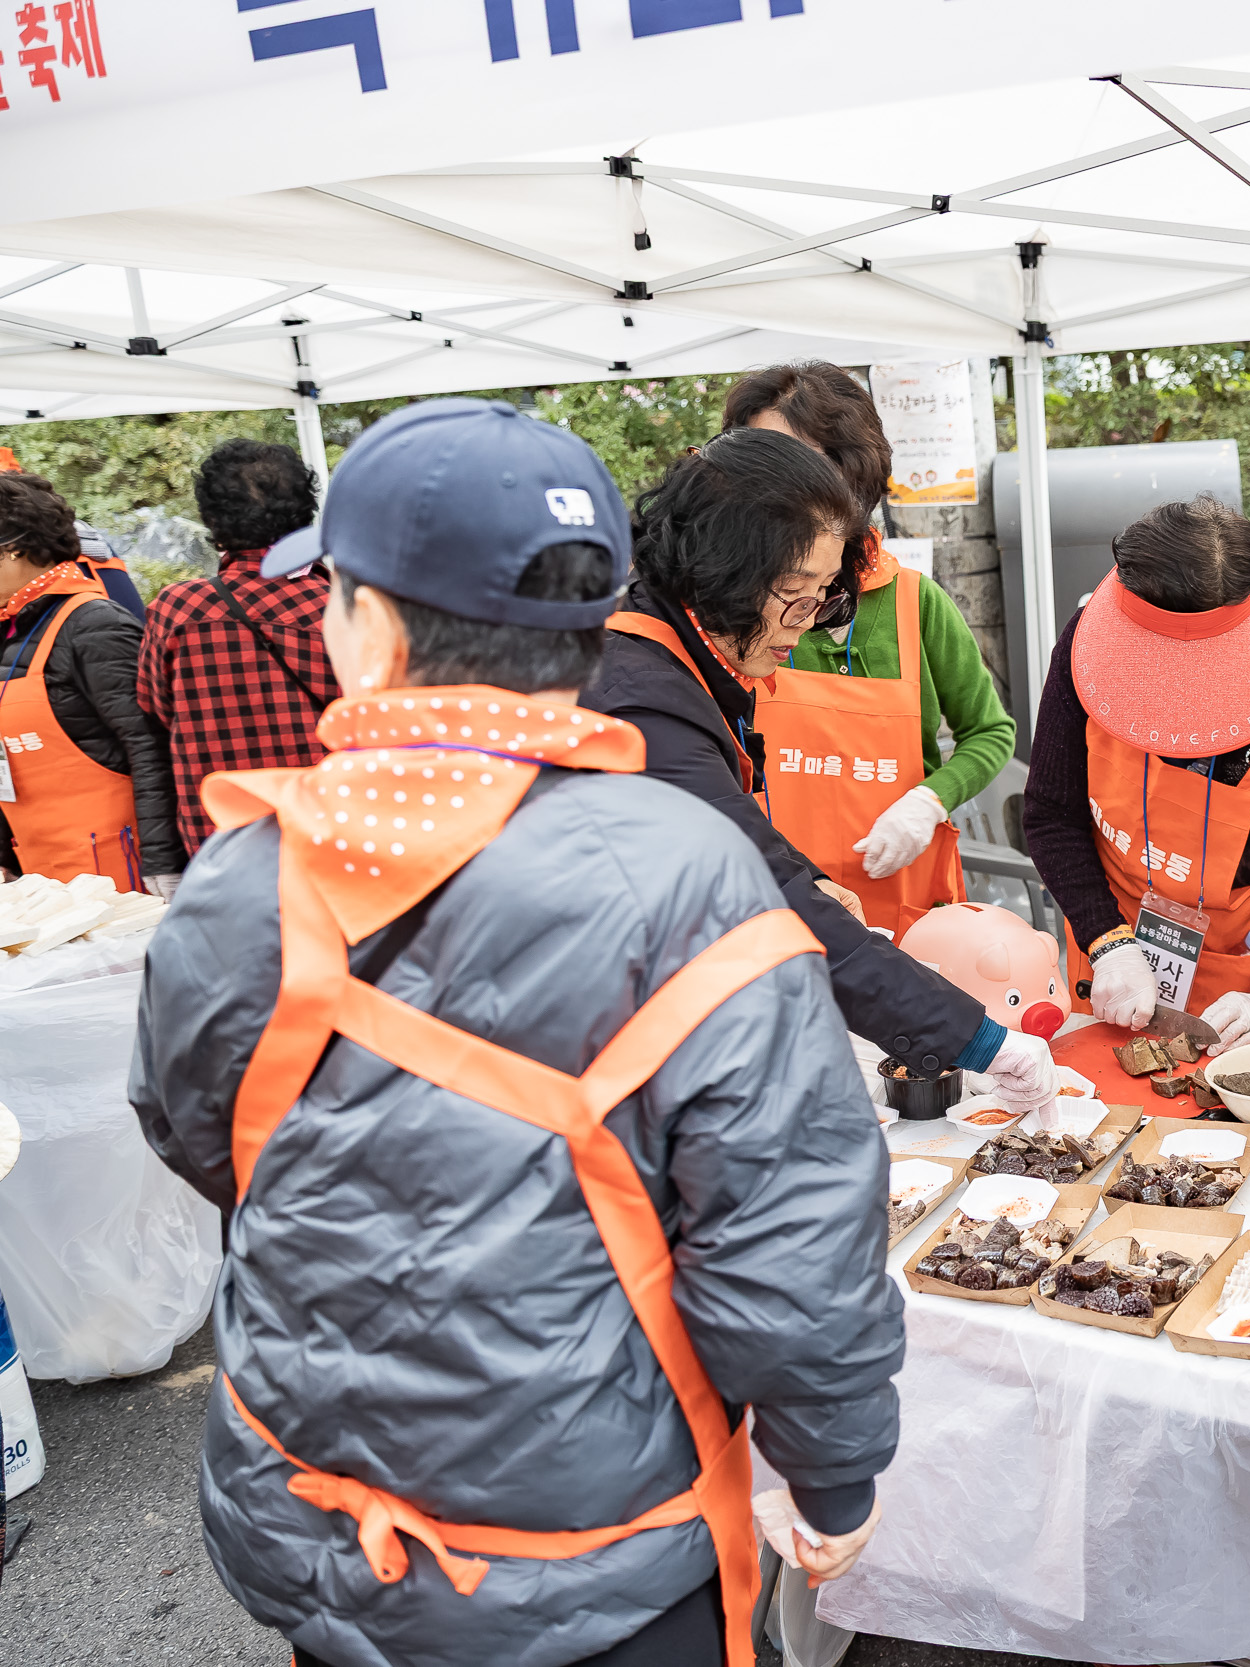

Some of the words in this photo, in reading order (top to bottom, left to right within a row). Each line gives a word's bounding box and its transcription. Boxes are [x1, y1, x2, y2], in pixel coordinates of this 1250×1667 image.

[0, 0, 107, 111] 축제
[779, 748, 843, 777] 감마을
[852, 757, 898, 783] 능동
[1139, 840, 1193, 883] 능동
[1158, 923, 1182, 940] 제8회
[4, 1439, 28, 1466] 30
[5, 1456, 31, 1476] ROLLS
